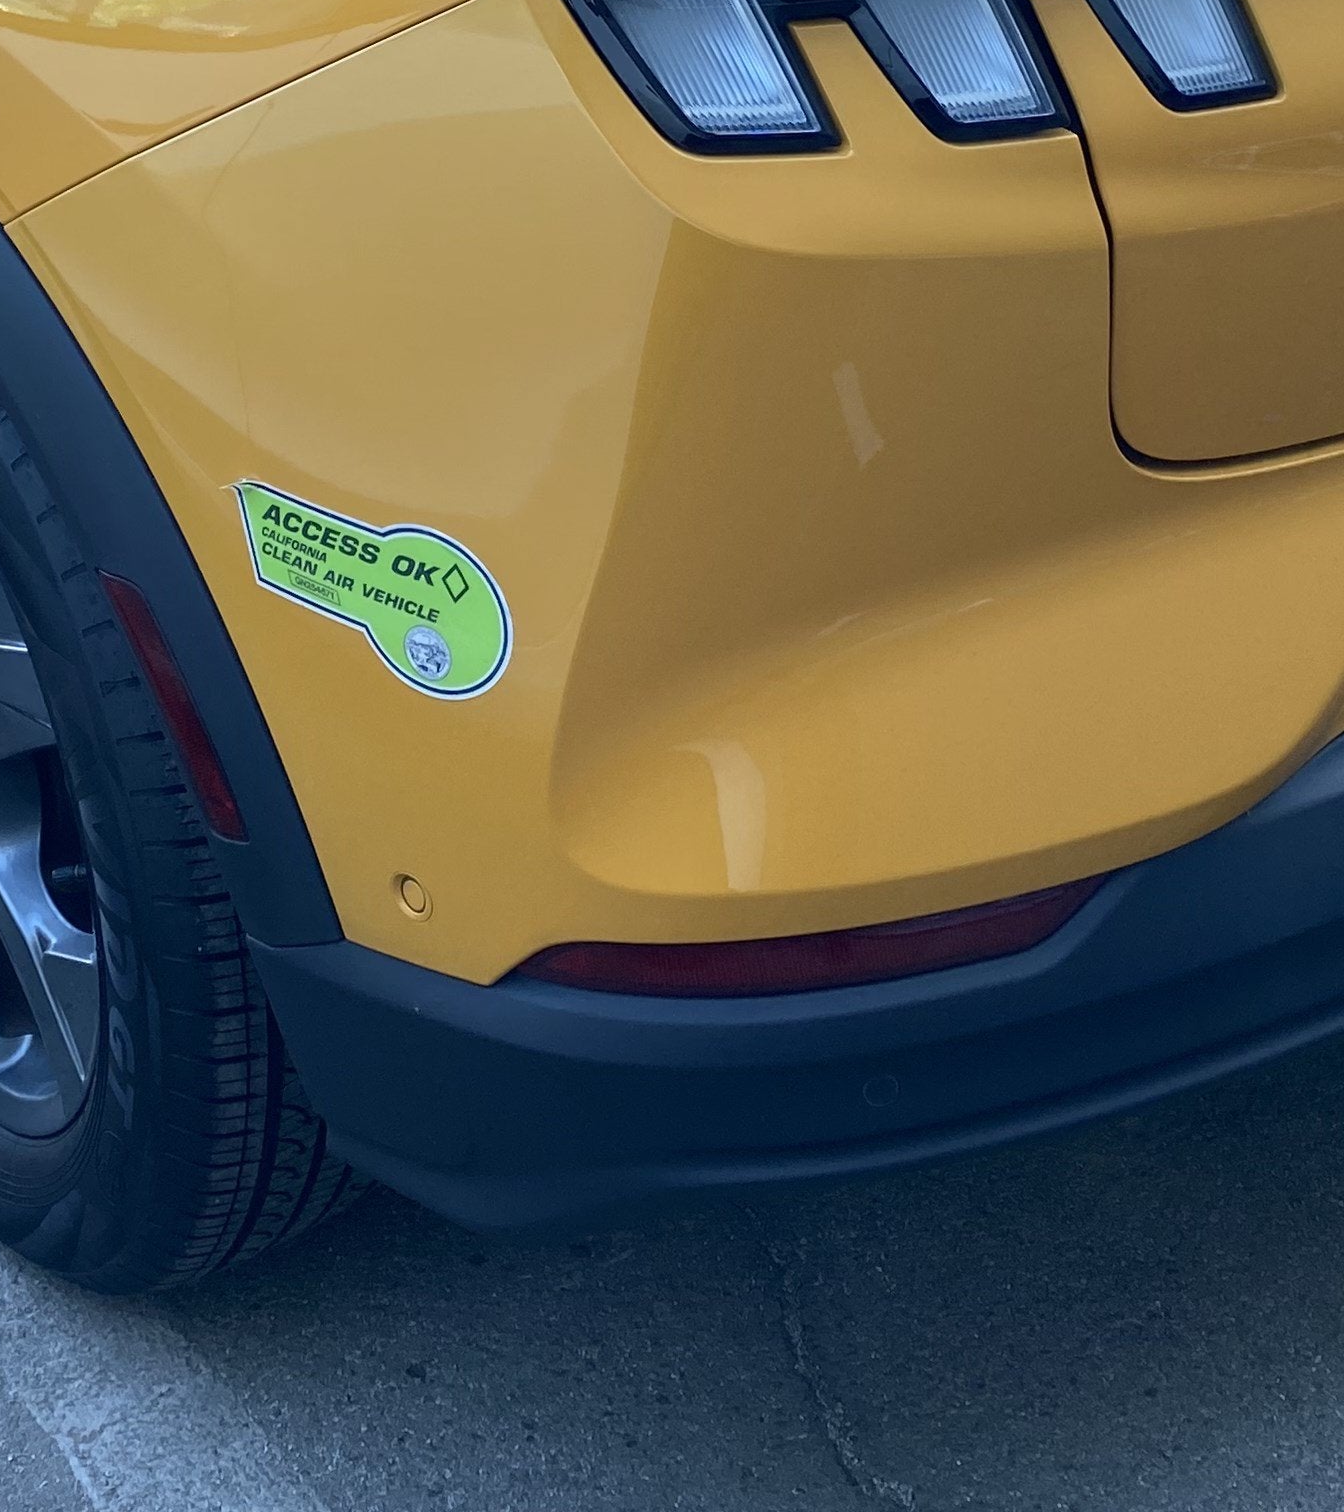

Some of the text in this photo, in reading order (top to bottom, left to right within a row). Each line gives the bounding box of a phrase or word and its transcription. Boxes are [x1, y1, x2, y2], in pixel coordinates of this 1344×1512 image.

[261, 525, 328, 563] CALIFORNIA
[261, 503, 440, 587] ACCESS OK
[261, 541, 318, 576] CLEAN
[323, 569, 355, 592] AIR
[362, 583, 441, 624] VEHICLE
